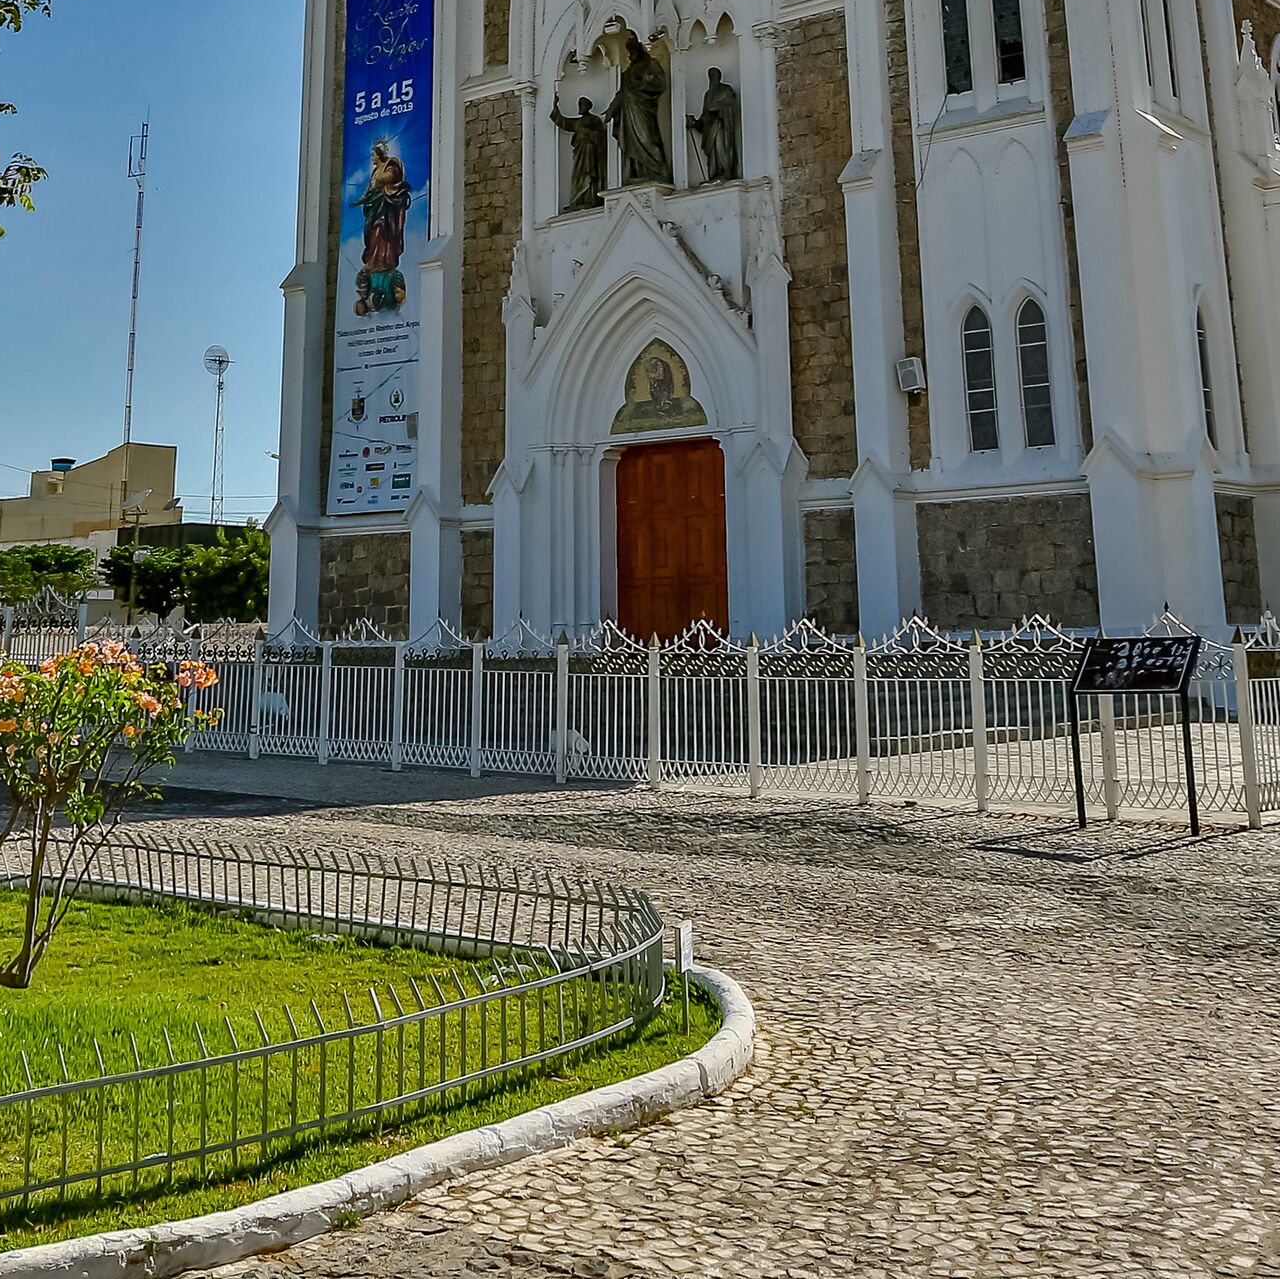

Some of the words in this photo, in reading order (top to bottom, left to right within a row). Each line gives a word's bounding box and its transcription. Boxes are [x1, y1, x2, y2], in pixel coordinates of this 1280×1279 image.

[355, 91, 366, 113] 5
[371, 92, 382, 109] a
[388, 79, 414, 105] 15
[354, 111, 379, 125] agosto
[380, 108, 391, 117] de
[391, 101, 414, 115] 2019
